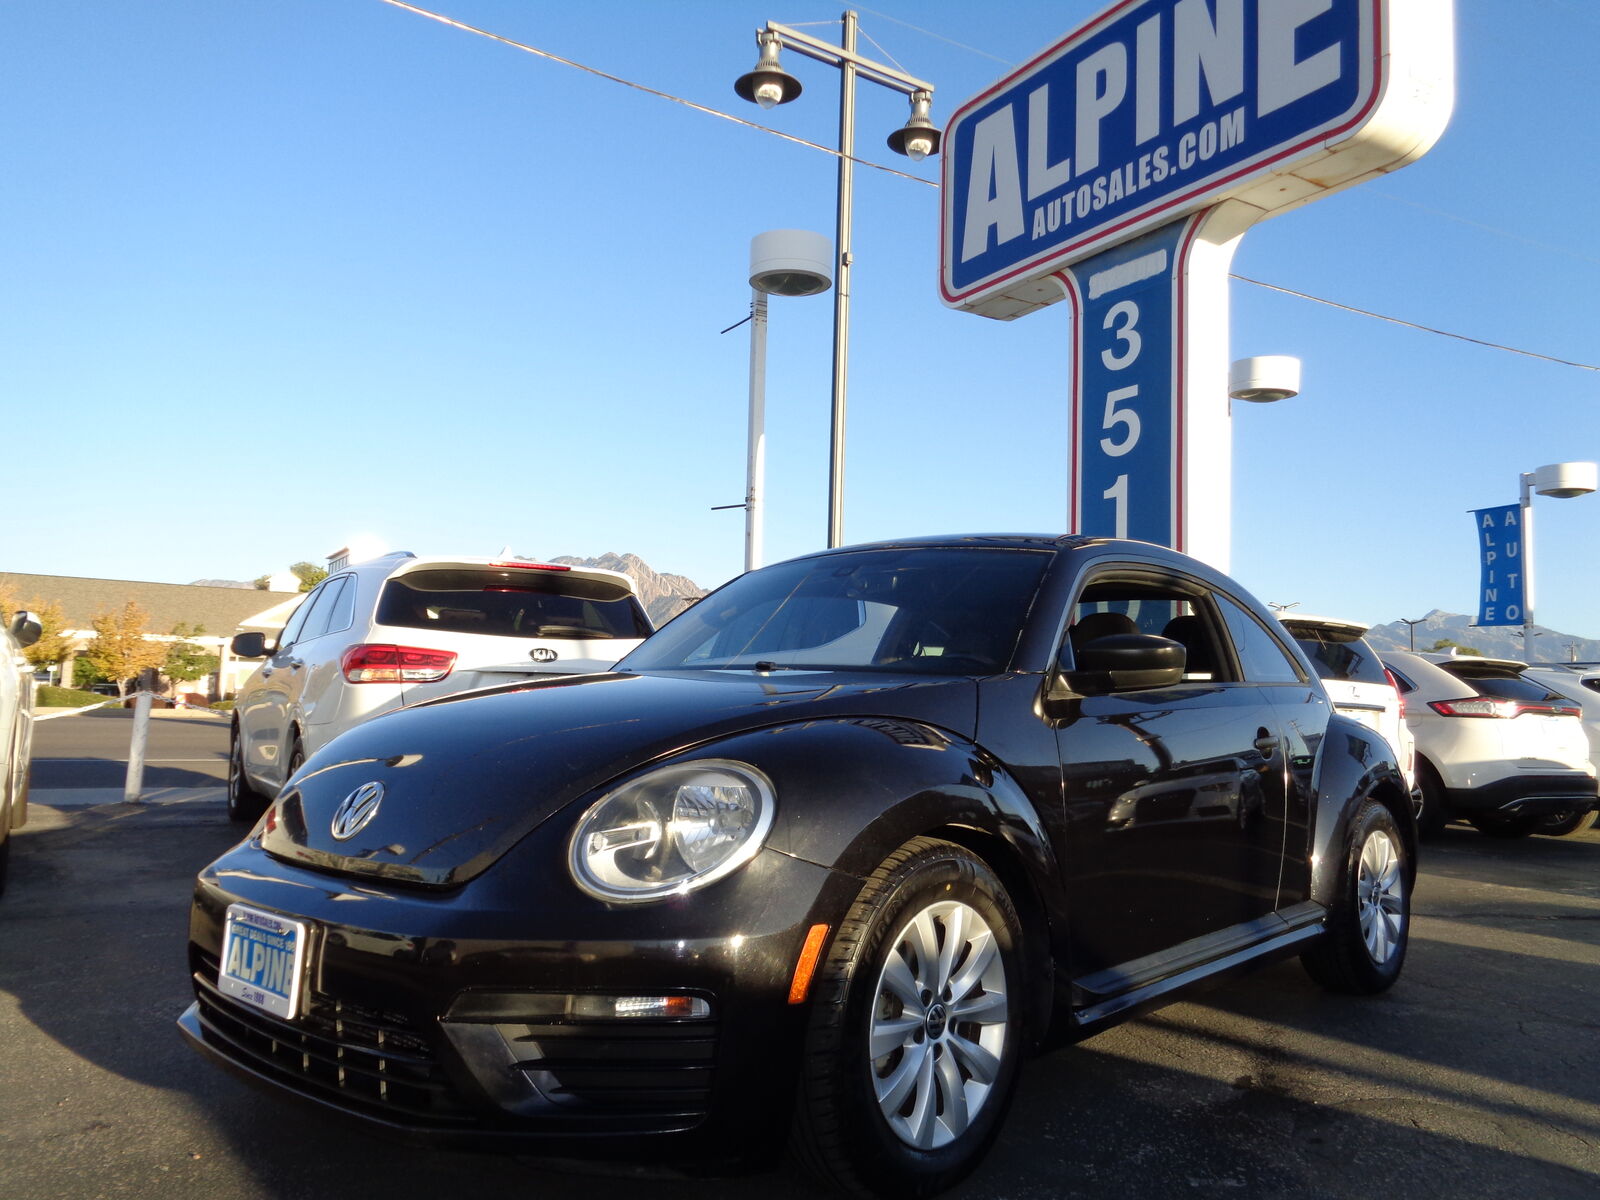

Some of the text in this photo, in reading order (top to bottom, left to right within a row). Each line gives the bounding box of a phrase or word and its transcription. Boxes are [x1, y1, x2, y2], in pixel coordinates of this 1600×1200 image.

[961, 0, 1342, 264] ALPINE
[1032, 106, 1246, 241] AUTOSALES.COM
[1482, 513, 1498, 621] ALPINE
[1504, 510, 1520, 621] AUTO
